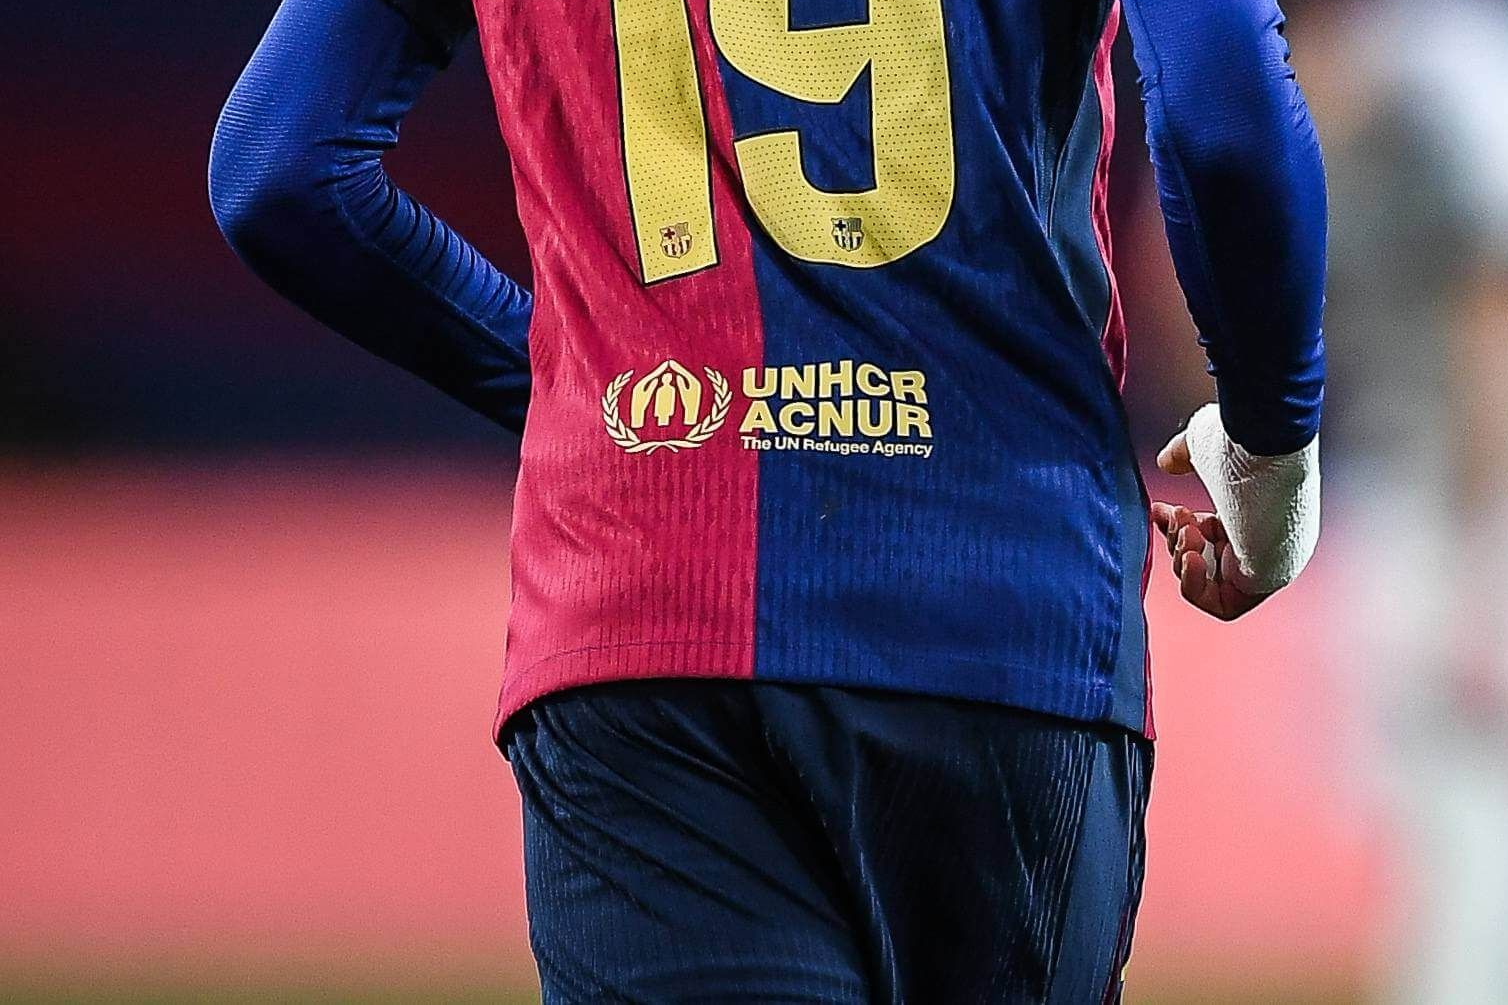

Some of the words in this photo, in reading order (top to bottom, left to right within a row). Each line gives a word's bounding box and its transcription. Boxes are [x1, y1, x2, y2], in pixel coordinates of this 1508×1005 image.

[742, 360, 928, 404] UNHCR
[739, 399, 933, 438] ACNUR
[741, 436, 772, 450] The
[775, 436, 801, 450] UN
[803, 439, 870, 455] Refugee
[872, 440, 933, 458] Agency
